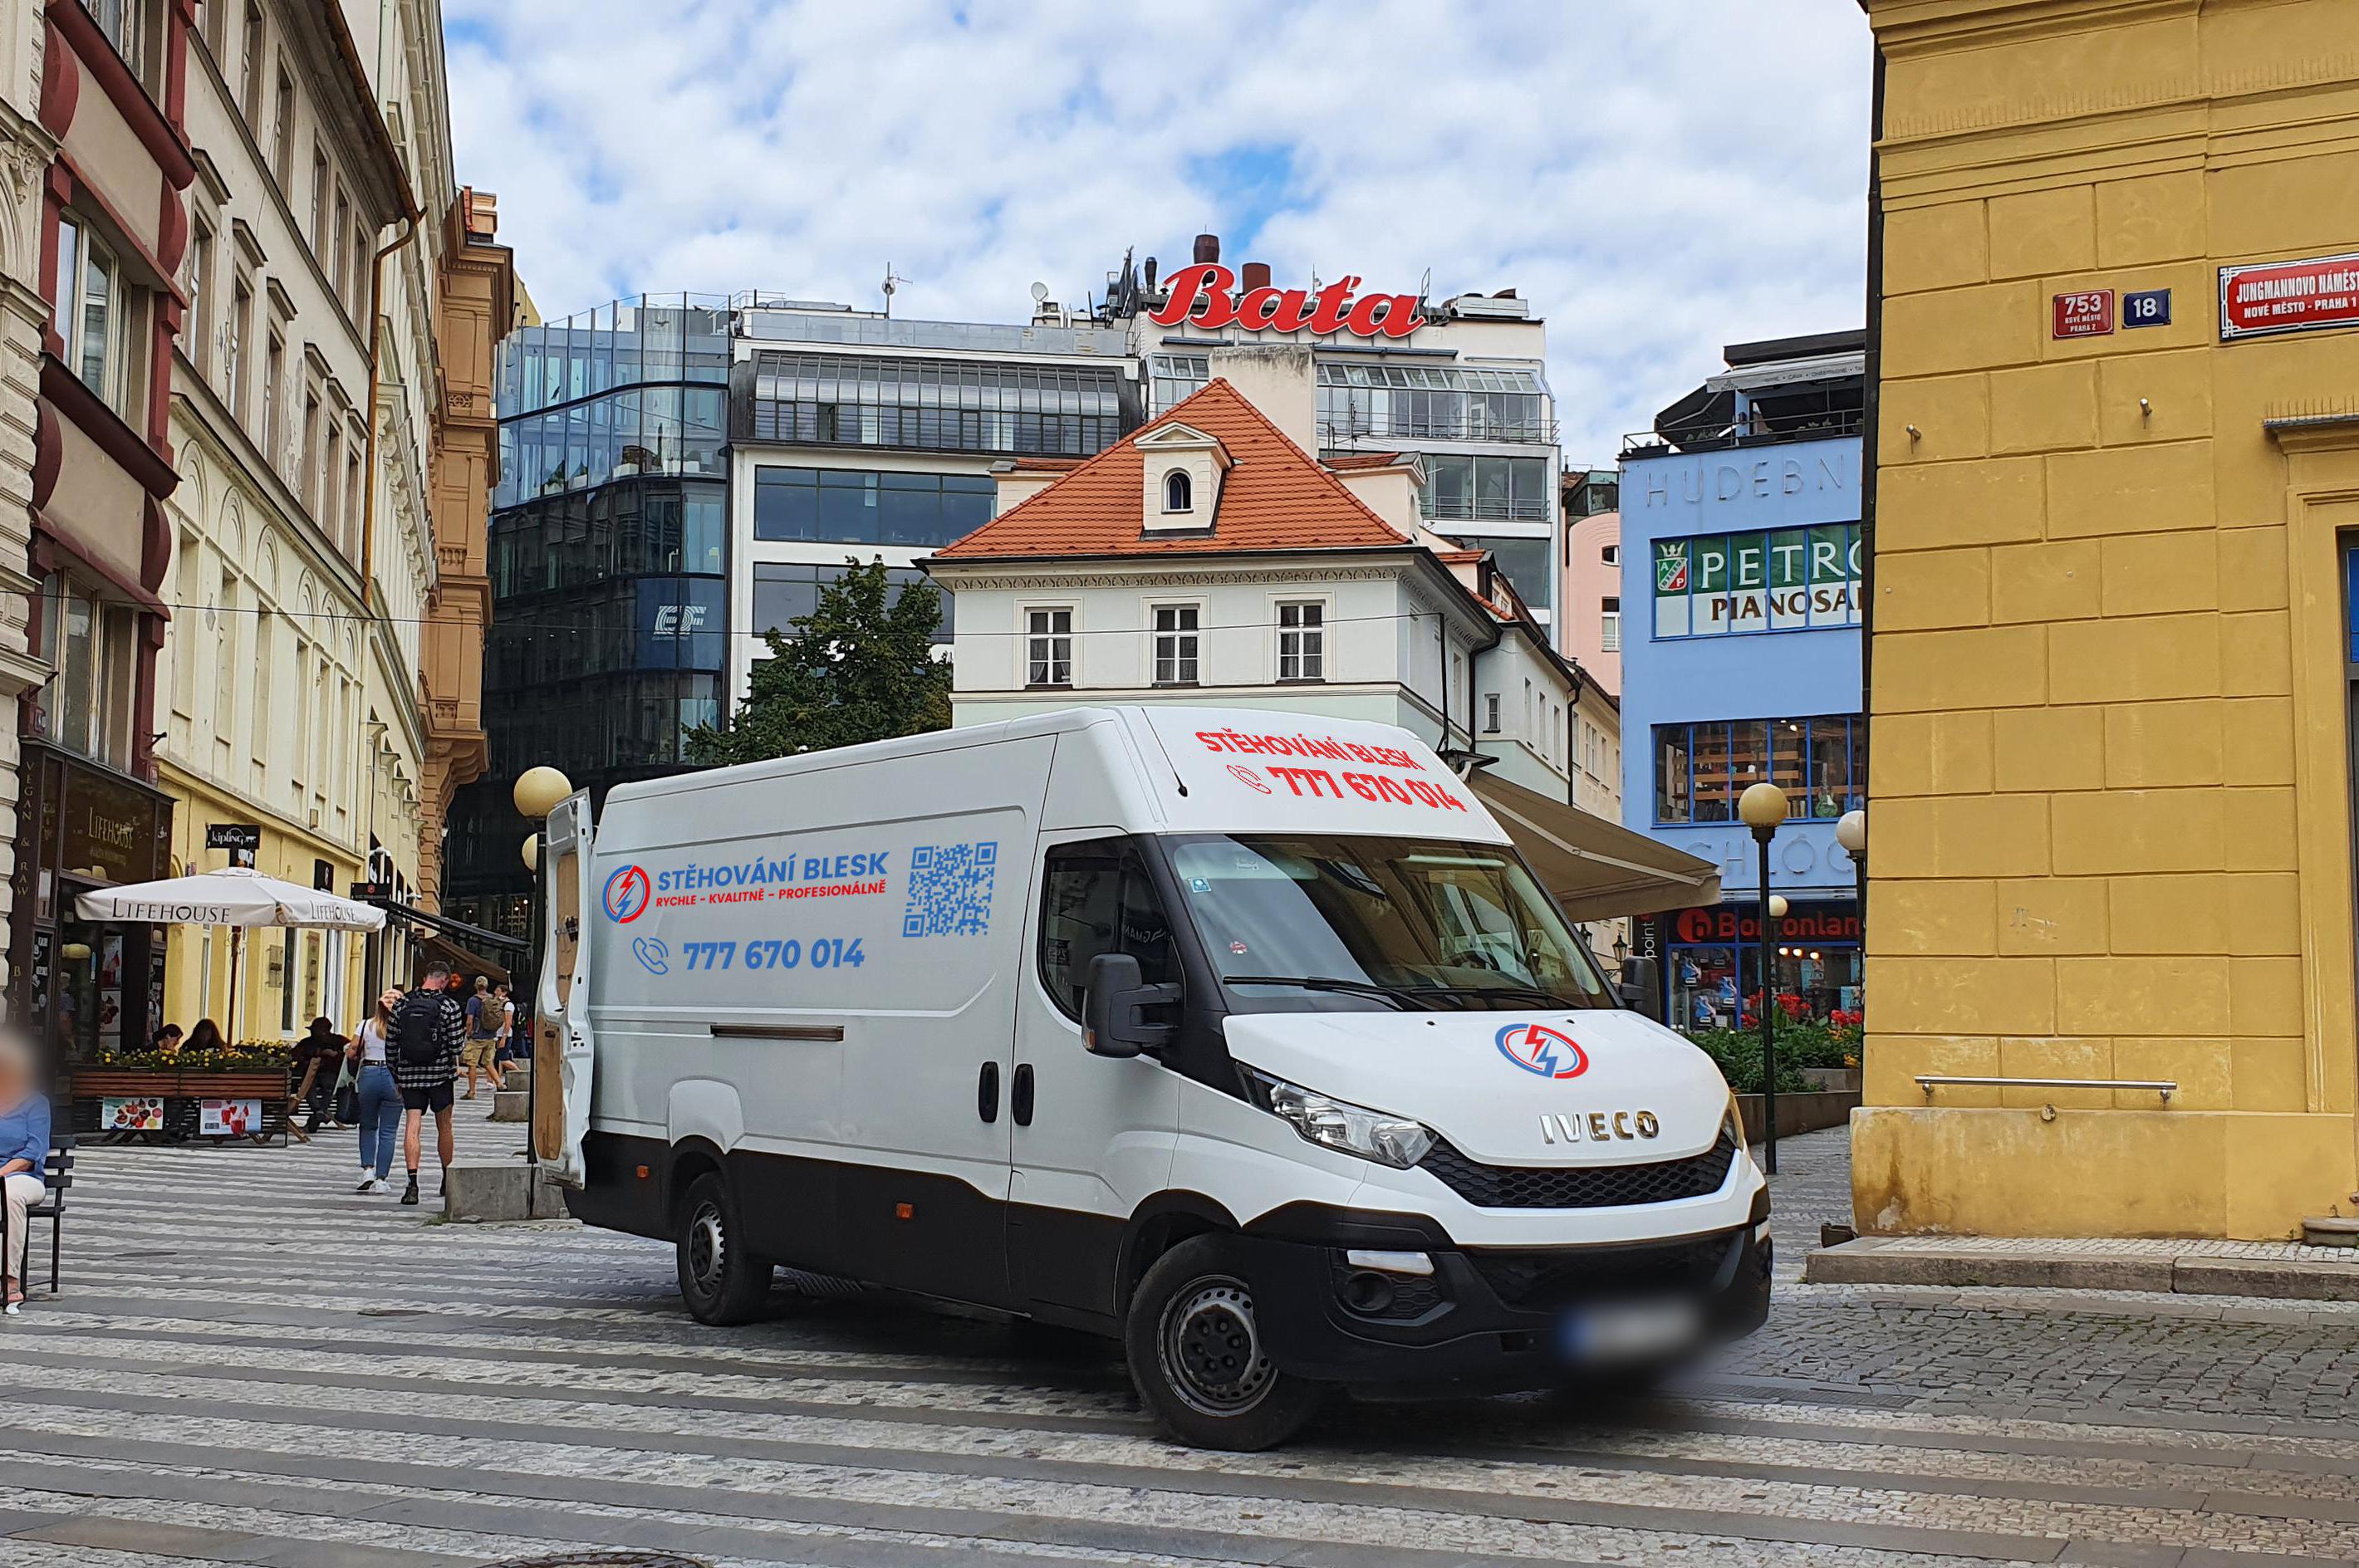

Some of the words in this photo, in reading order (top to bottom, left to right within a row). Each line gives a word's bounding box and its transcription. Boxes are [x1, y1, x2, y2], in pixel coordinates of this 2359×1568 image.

[1148, 262, 1426, 338] Baťa
[2065, 294, 2102, 316] 753
[2236, 275, 2316, 304] JUNGMANNOVO
[2065, 315, 2081, 324] NOVÉ
[2133, 297, 2157, 318] 18
[2244, 303, 2269, 319] NOVÉ
[2272, 300, 2305, 316] MĚSTO
[2314, 296, 2349, 311] PRAHA
[2351, 296, 2357, 307] 1
[2070, 324, 2091, 332] PRAHA
[1195, 728, 1352, 761] STĚHOVÁNÍ
[1343, 742, 1427, 772] BLESK
[22, 761, 35, 821] VEGAN
[1265, 766, 1345, 799] 777
[1341, 772, 1414, 806] 670
[1405, 778, 1469, 813] 014
[212, 830, 245, 845] kipling
[17, 860, 28, 896] RAW
[657, 853, 797, 891] STĚHOVÁNÍ
[803, 851, 890, 880] BLESK
[655, 894, 697, 908] RYCHLE
[709, 889, 765, 904] KVALITNĚ
[778, 880, 887, 900] PROFESIONÁLNĚ
[683, 942, 737, 971] 777
[744, 938, 801, 970] 670
[810, 938, 866, 969] 014
[1641, 920, 1658, 958] point
[1538, 1110, 1660, 1144] IVECO
